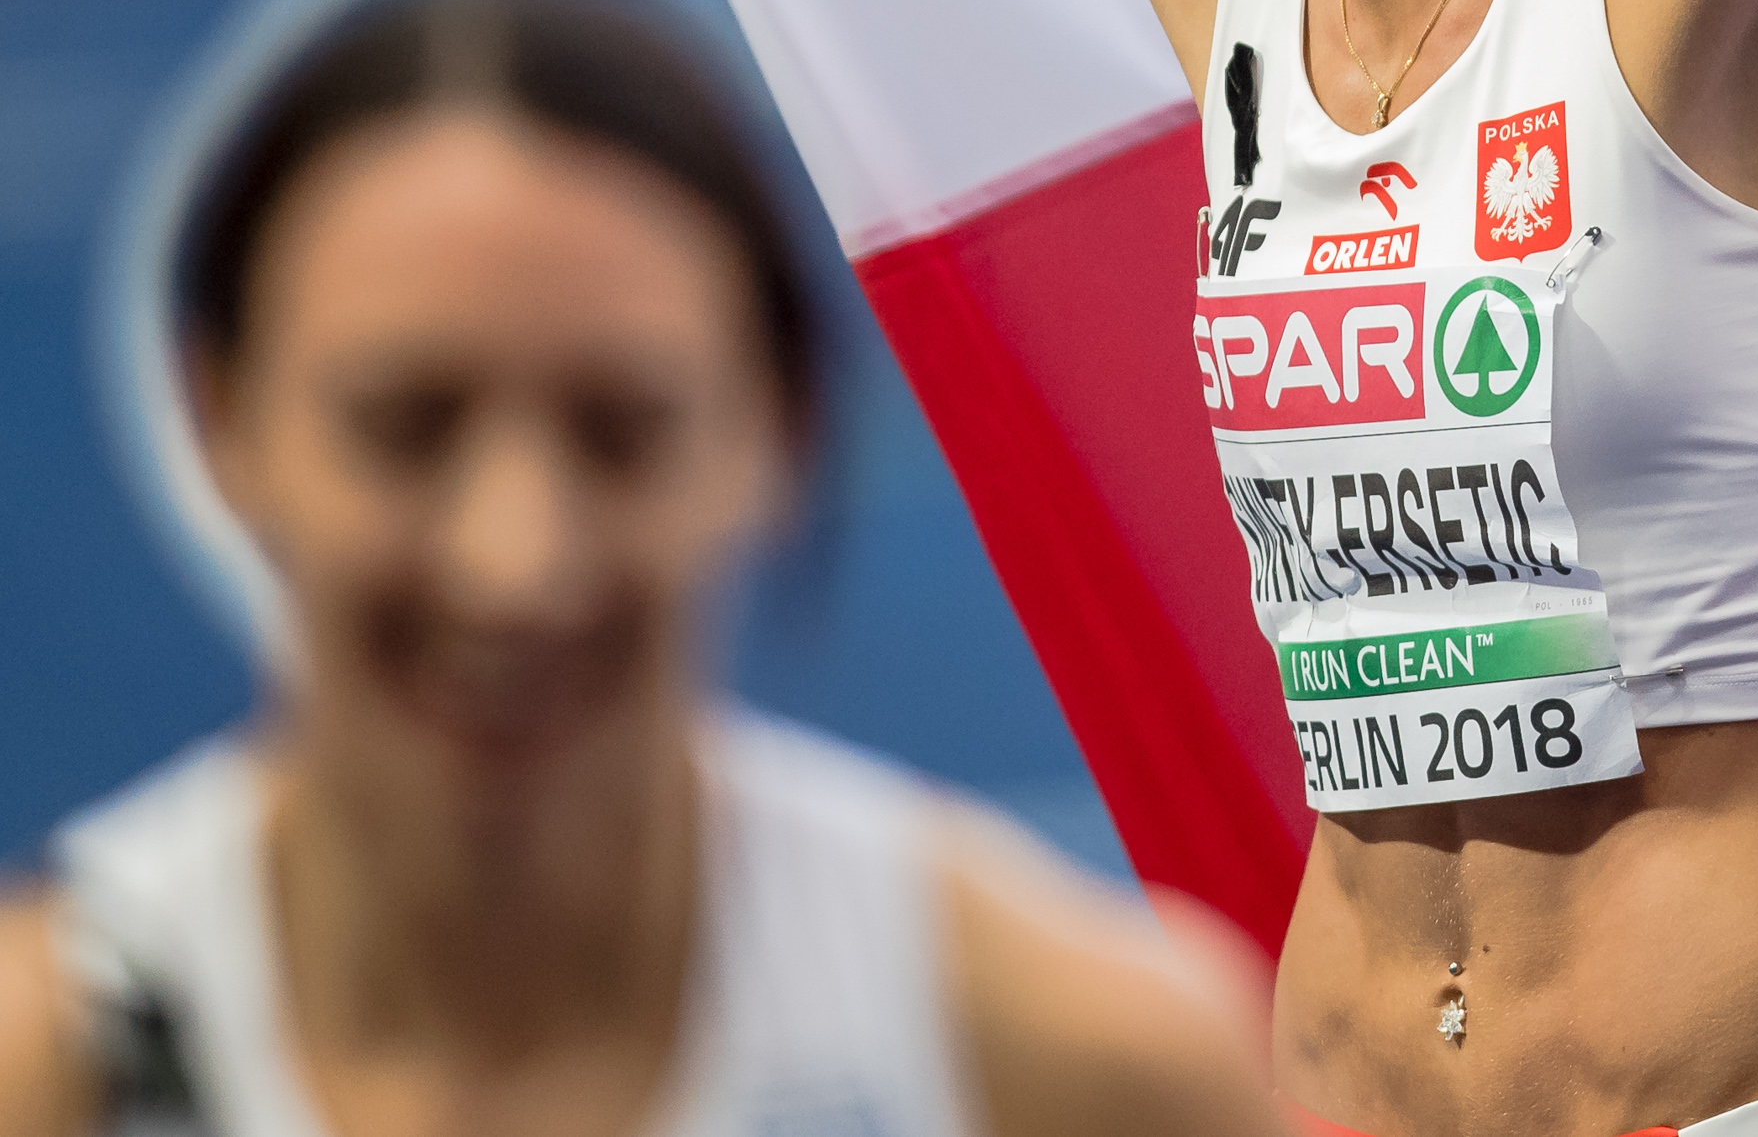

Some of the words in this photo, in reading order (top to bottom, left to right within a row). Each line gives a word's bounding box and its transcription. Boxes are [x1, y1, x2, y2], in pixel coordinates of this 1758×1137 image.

[1483, 108, 1561, 145] POLSKA
[1312, 231, 1413, 273] ORLEN
[1535, 601, 1552, 611] POL
[1291, 650, 1300, 692] I
[1300, 648, 1351, 692] RUN
[1290, 714, 1408, 792] ERLIN
[1419, 697, 1583, 783] 2018
